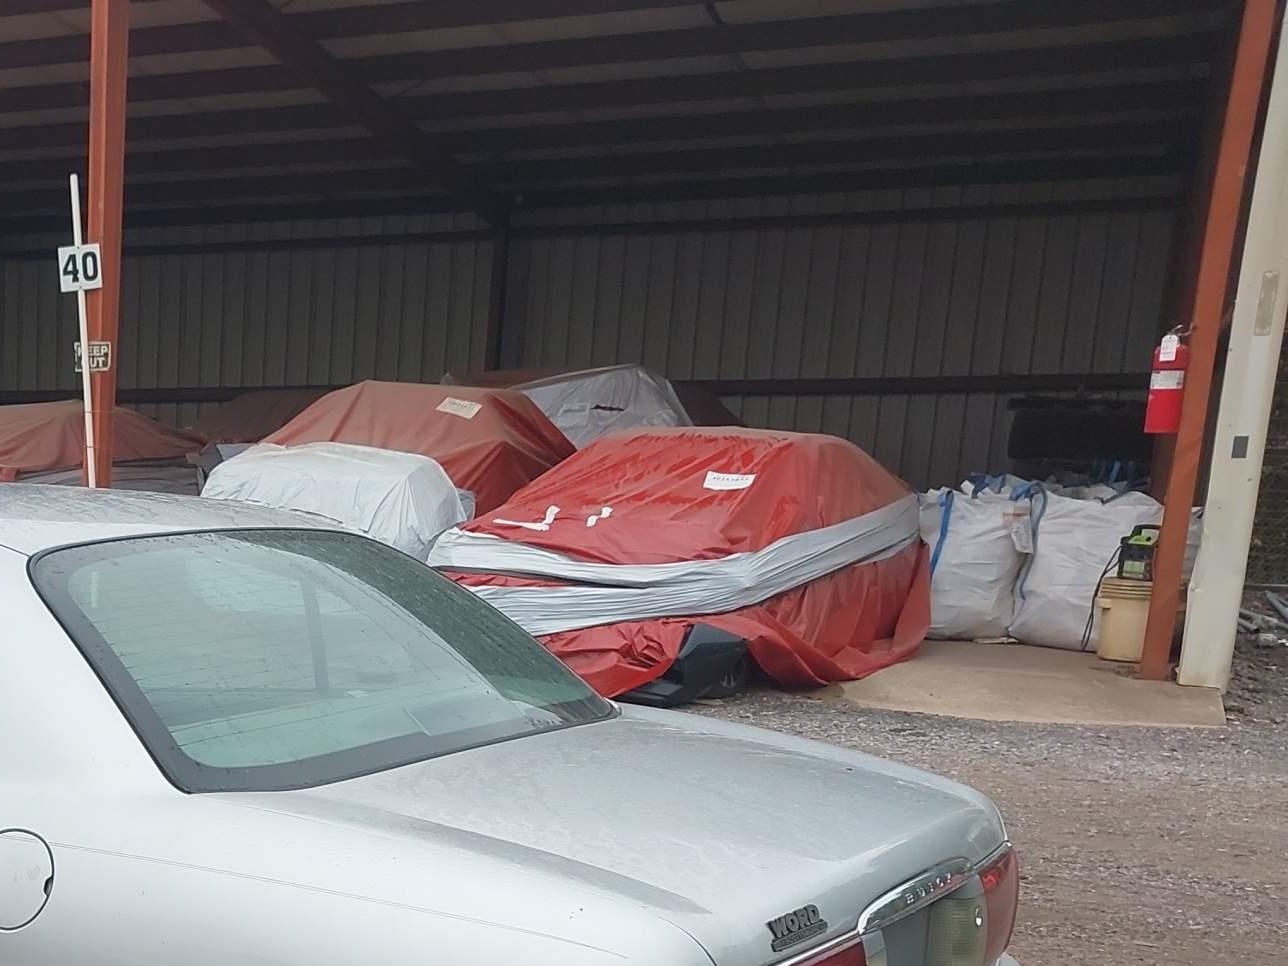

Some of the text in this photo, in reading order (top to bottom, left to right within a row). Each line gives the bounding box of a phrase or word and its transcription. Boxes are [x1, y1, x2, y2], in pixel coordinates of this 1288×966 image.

[63, 251, 98, 283] 40
[81, 357, 106, 368] UT
[766, 904, 820, 939] WORD
